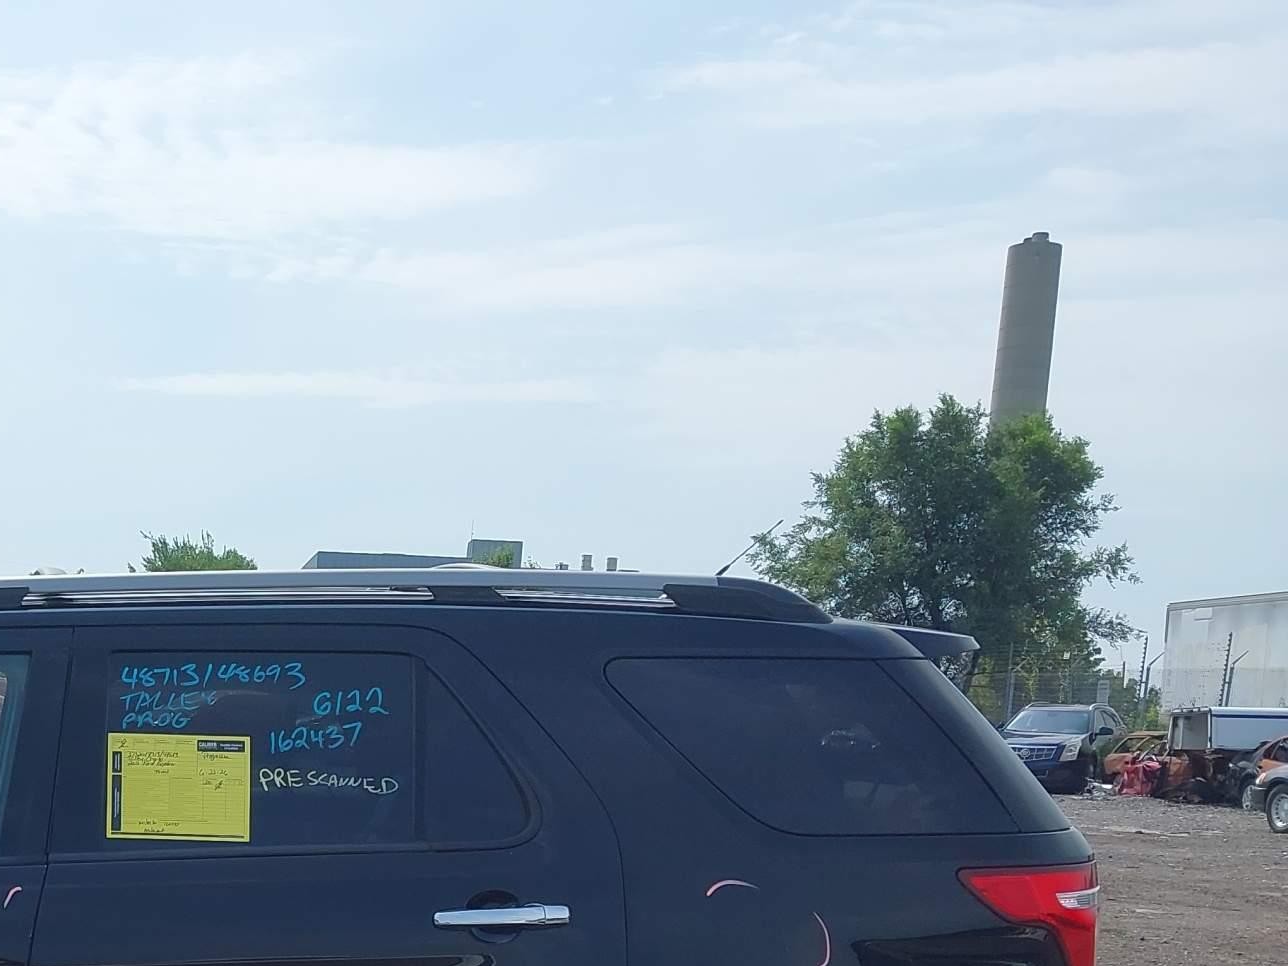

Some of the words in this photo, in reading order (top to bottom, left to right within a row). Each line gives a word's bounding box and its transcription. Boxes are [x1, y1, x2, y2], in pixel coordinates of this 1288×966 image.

[120, 662, 306, 690] 48713/48693
[312, 687, 391, 716] 6122
[269, 721, 363, 754] 162437
